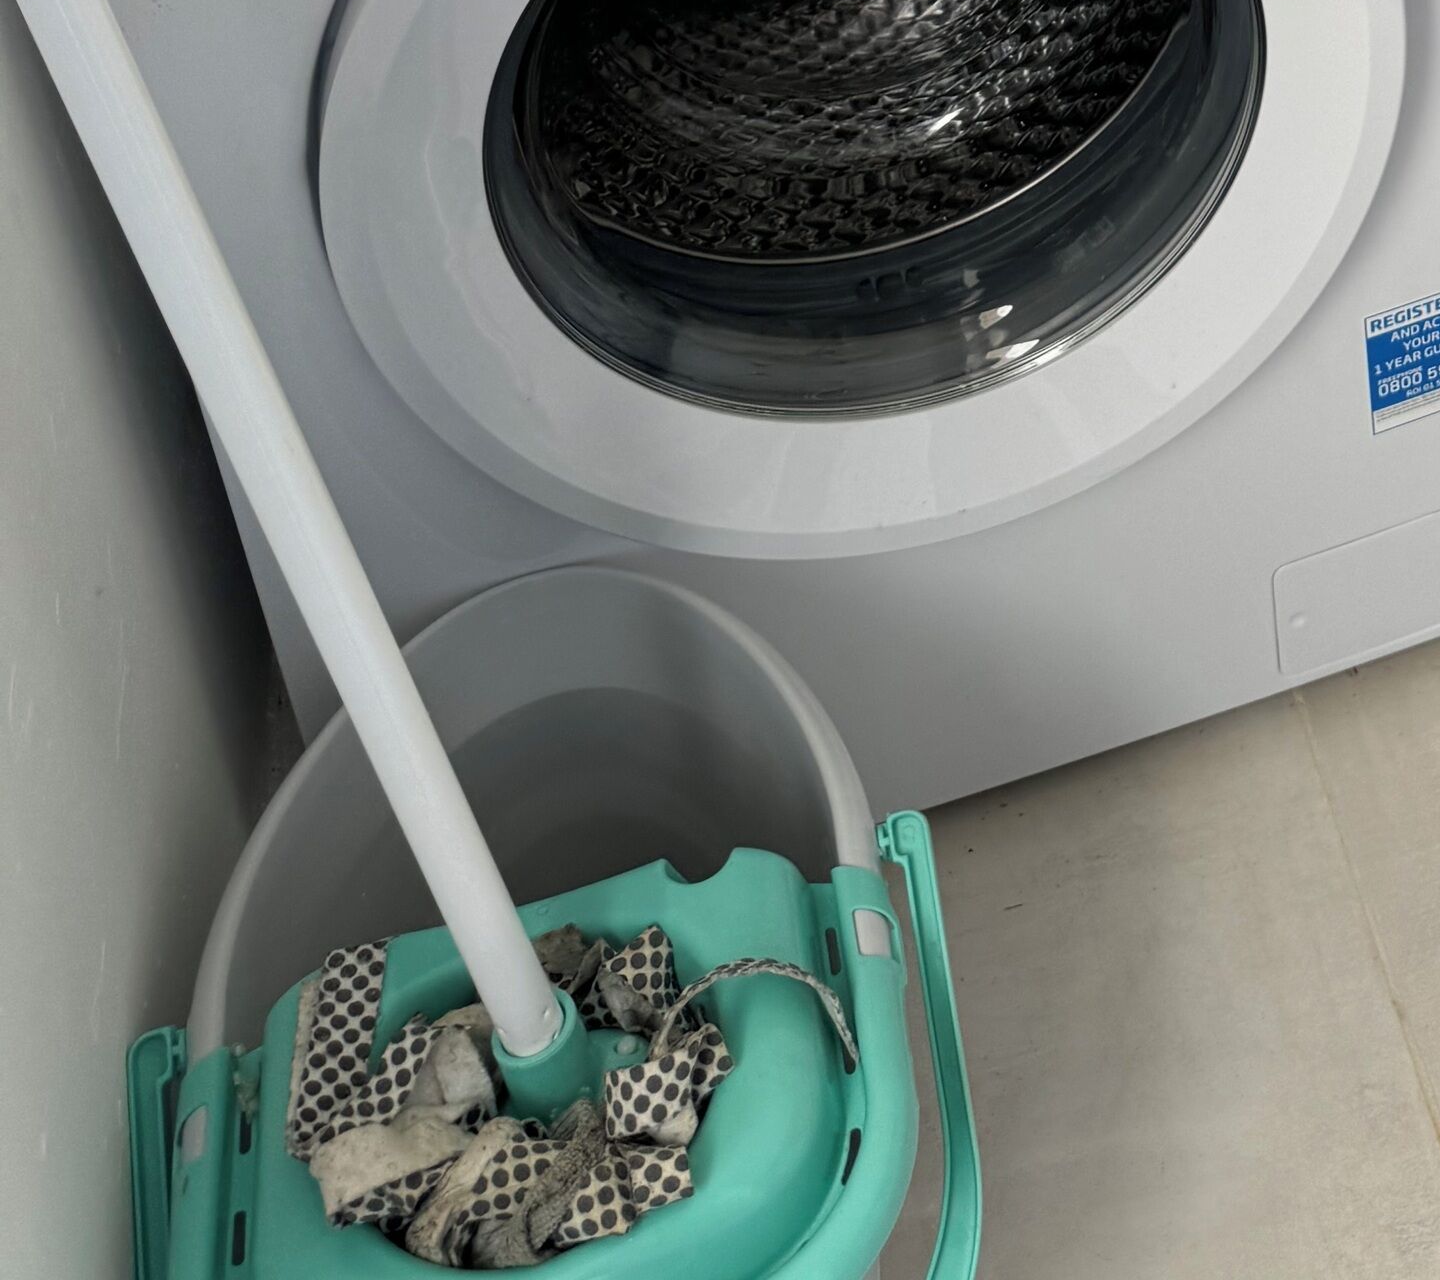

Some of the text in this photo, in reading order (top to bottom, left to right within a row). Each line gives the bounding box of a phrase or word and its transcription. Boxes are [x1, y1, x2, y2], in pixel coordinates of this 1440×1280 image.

[1391, 324, 1420, 343] AND
[1403, 330, 1440, 351] YOUR
[1374, 364, 1382, 375] 1
[1386, 351, 1422, 371] YEAR
[1378, 372, 1423, 398] 0800
